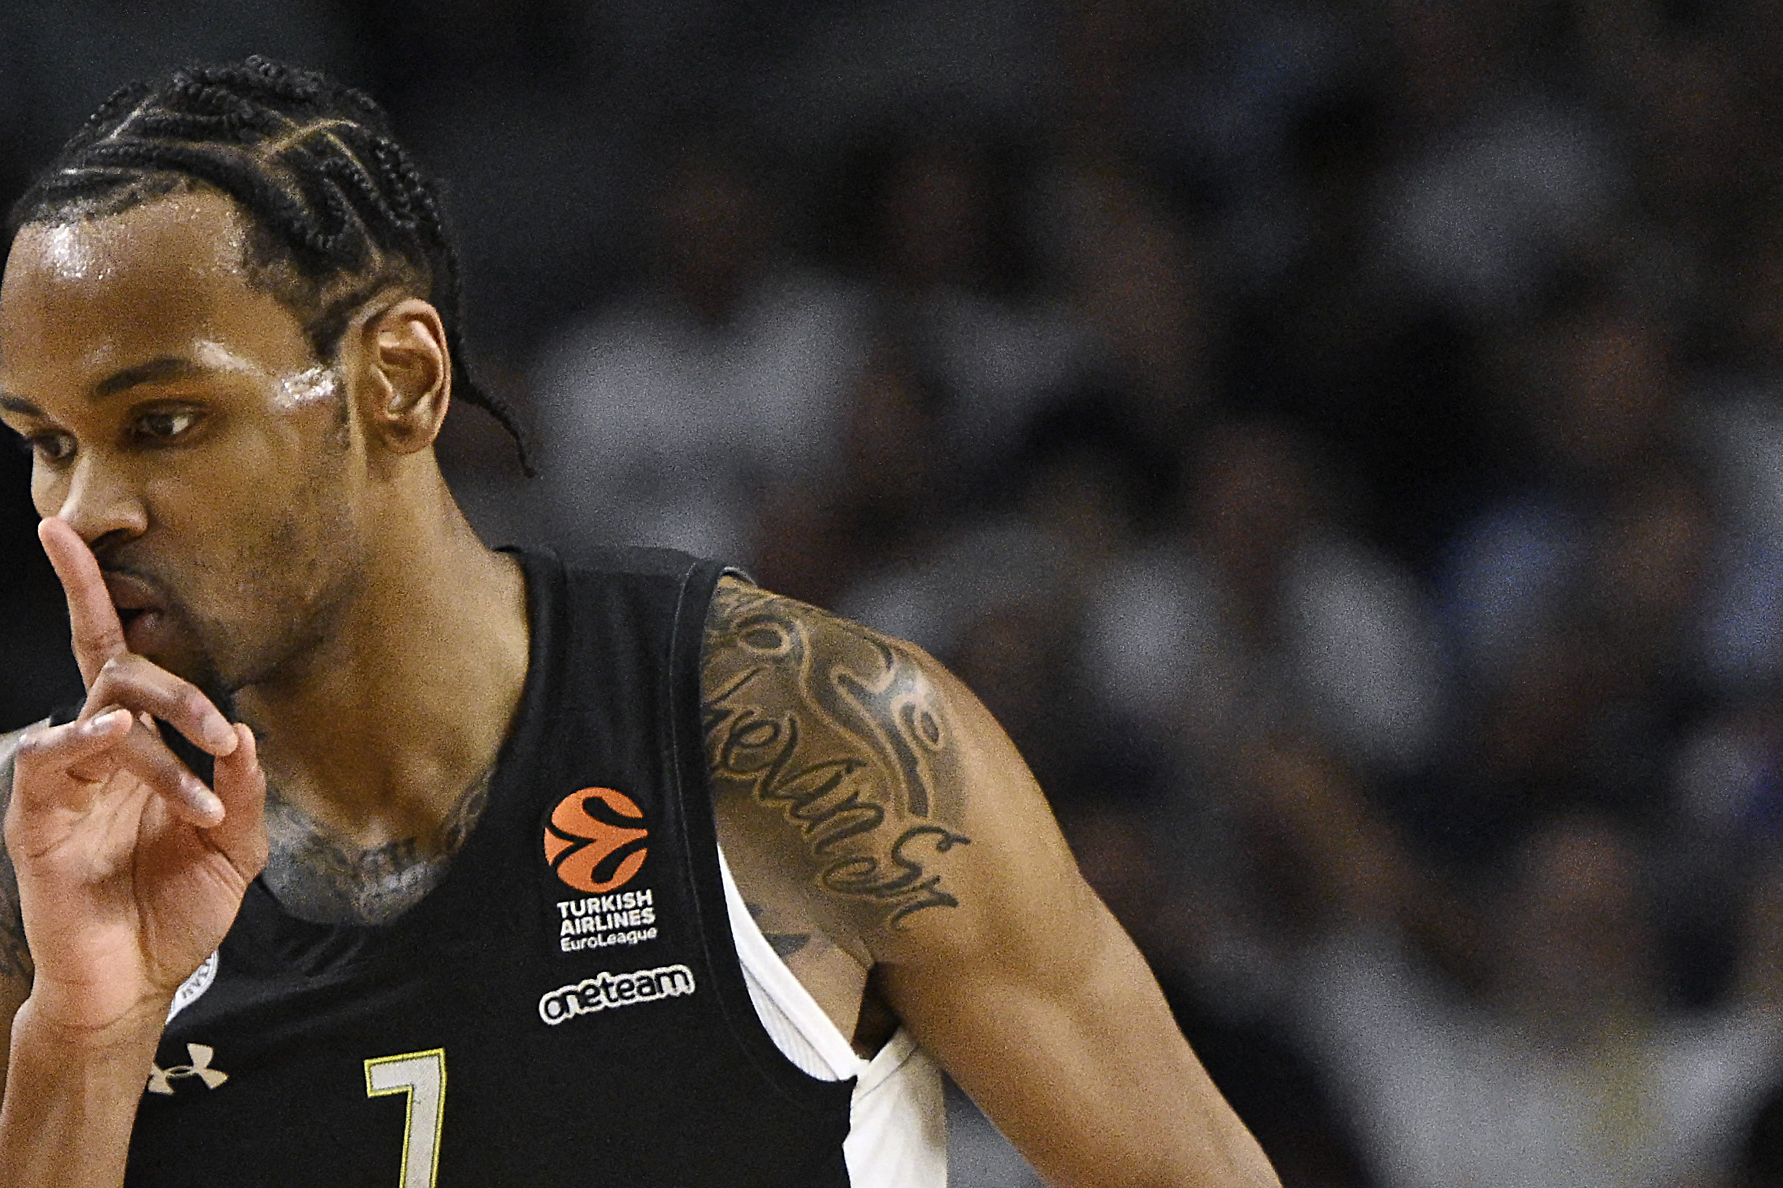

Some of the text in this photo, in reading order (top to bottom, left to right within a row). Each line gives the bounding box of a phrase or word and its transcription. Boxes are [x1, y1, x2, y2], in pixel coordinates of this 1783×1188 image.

[557, 889, 653, 918] TURKISH
[560, 907, 655, 936] AIRLINES
[561, 927, 658, 952] EuroLeague
[539, 965, 695, 1024] oneteam
